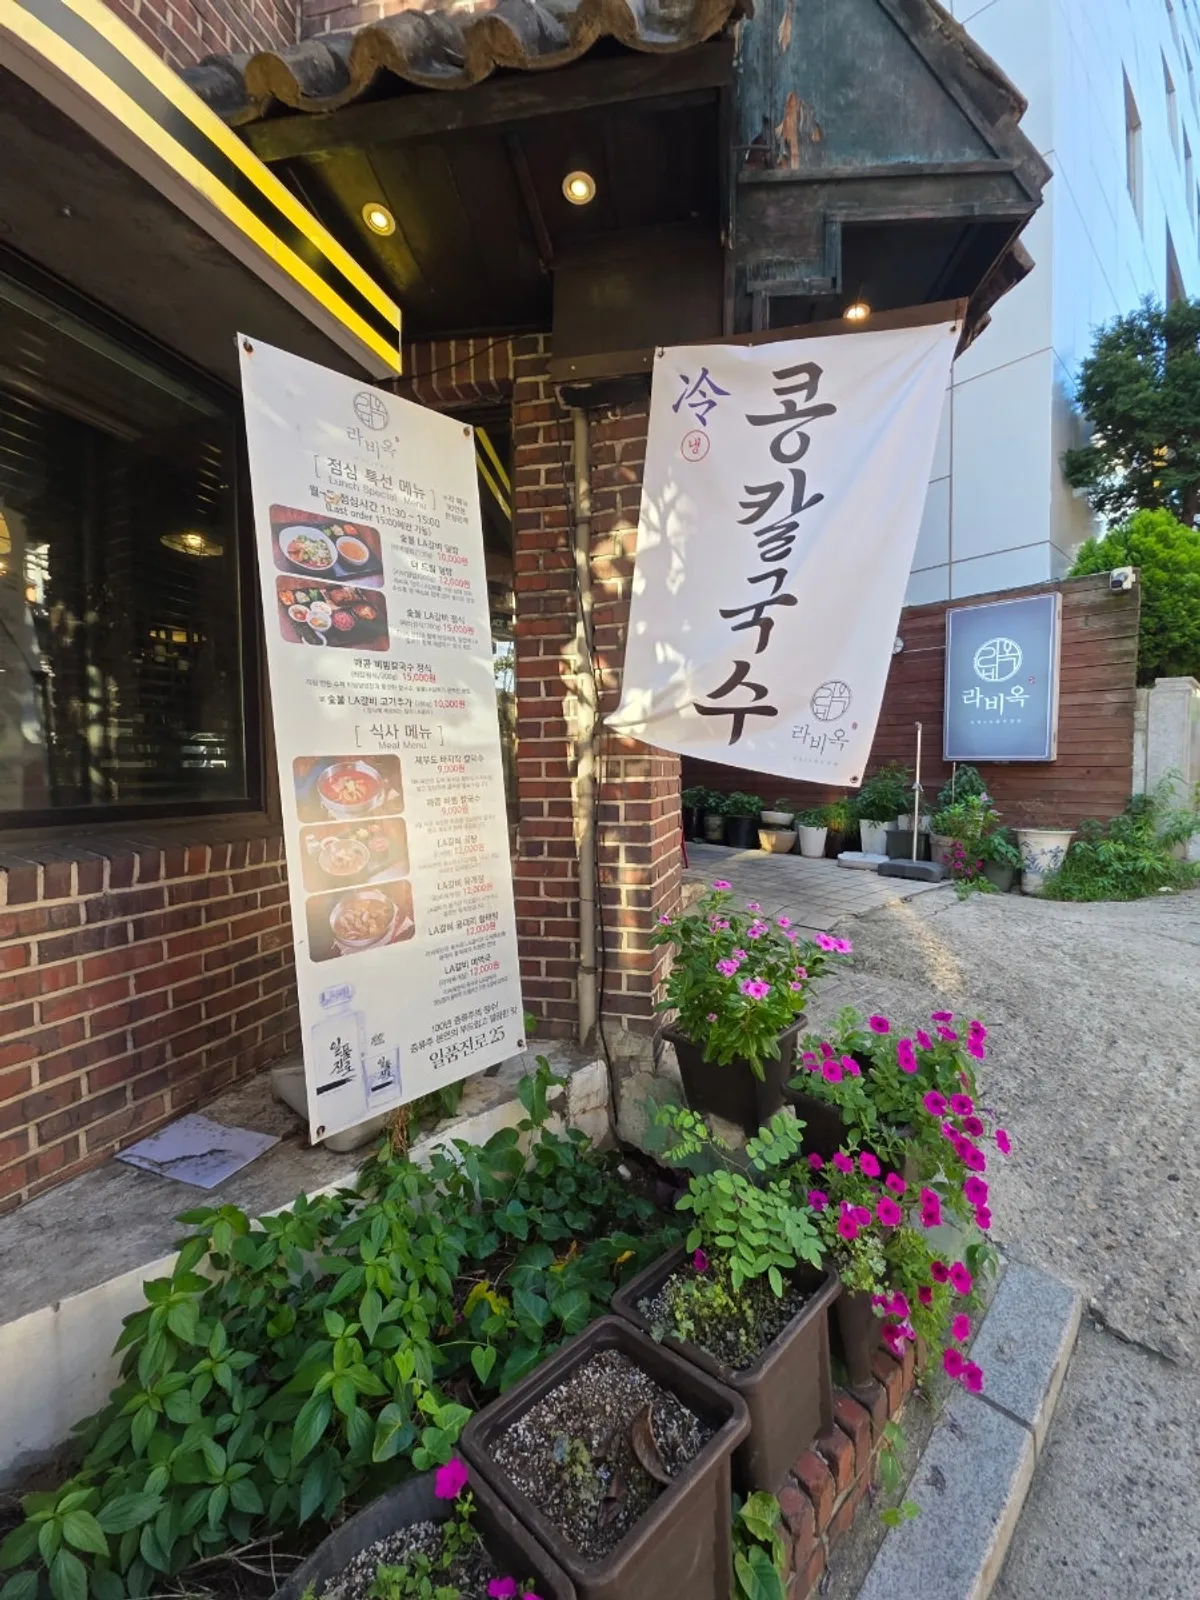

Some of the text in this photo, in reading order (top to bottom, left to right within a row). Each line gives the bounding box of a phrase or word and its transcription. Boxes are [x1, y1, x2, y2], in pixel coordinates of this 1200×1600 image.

[346, 426, 397, 460] 라비옥
[327, 457, 358, 481] 점심
[365, 469, 393, 492] 특선
[399, 478, 426, 500] 메뉴
[328, 475, 360, 493] Lunch
[363, 485, 398, 503] Special
[339, 493, 378, 512] 점심시간
[381, 503, 407, 520] 11:30
[417, 514, 440, 528] 15:00
[692, 360, 838, 746] 콩칼국수
[402, 671, 436, 684] 15,000원
[347, 695, 378, 707] LA갈비
[961, 684, 1031, 716] 라비옥
[369, 724, 432, 740] 식사 메뉴
[378, 740, 427, 750] Meal Menu
[791, 723, 850, 755] 라비옥
[443, 960, 470, 975] LA갈비
